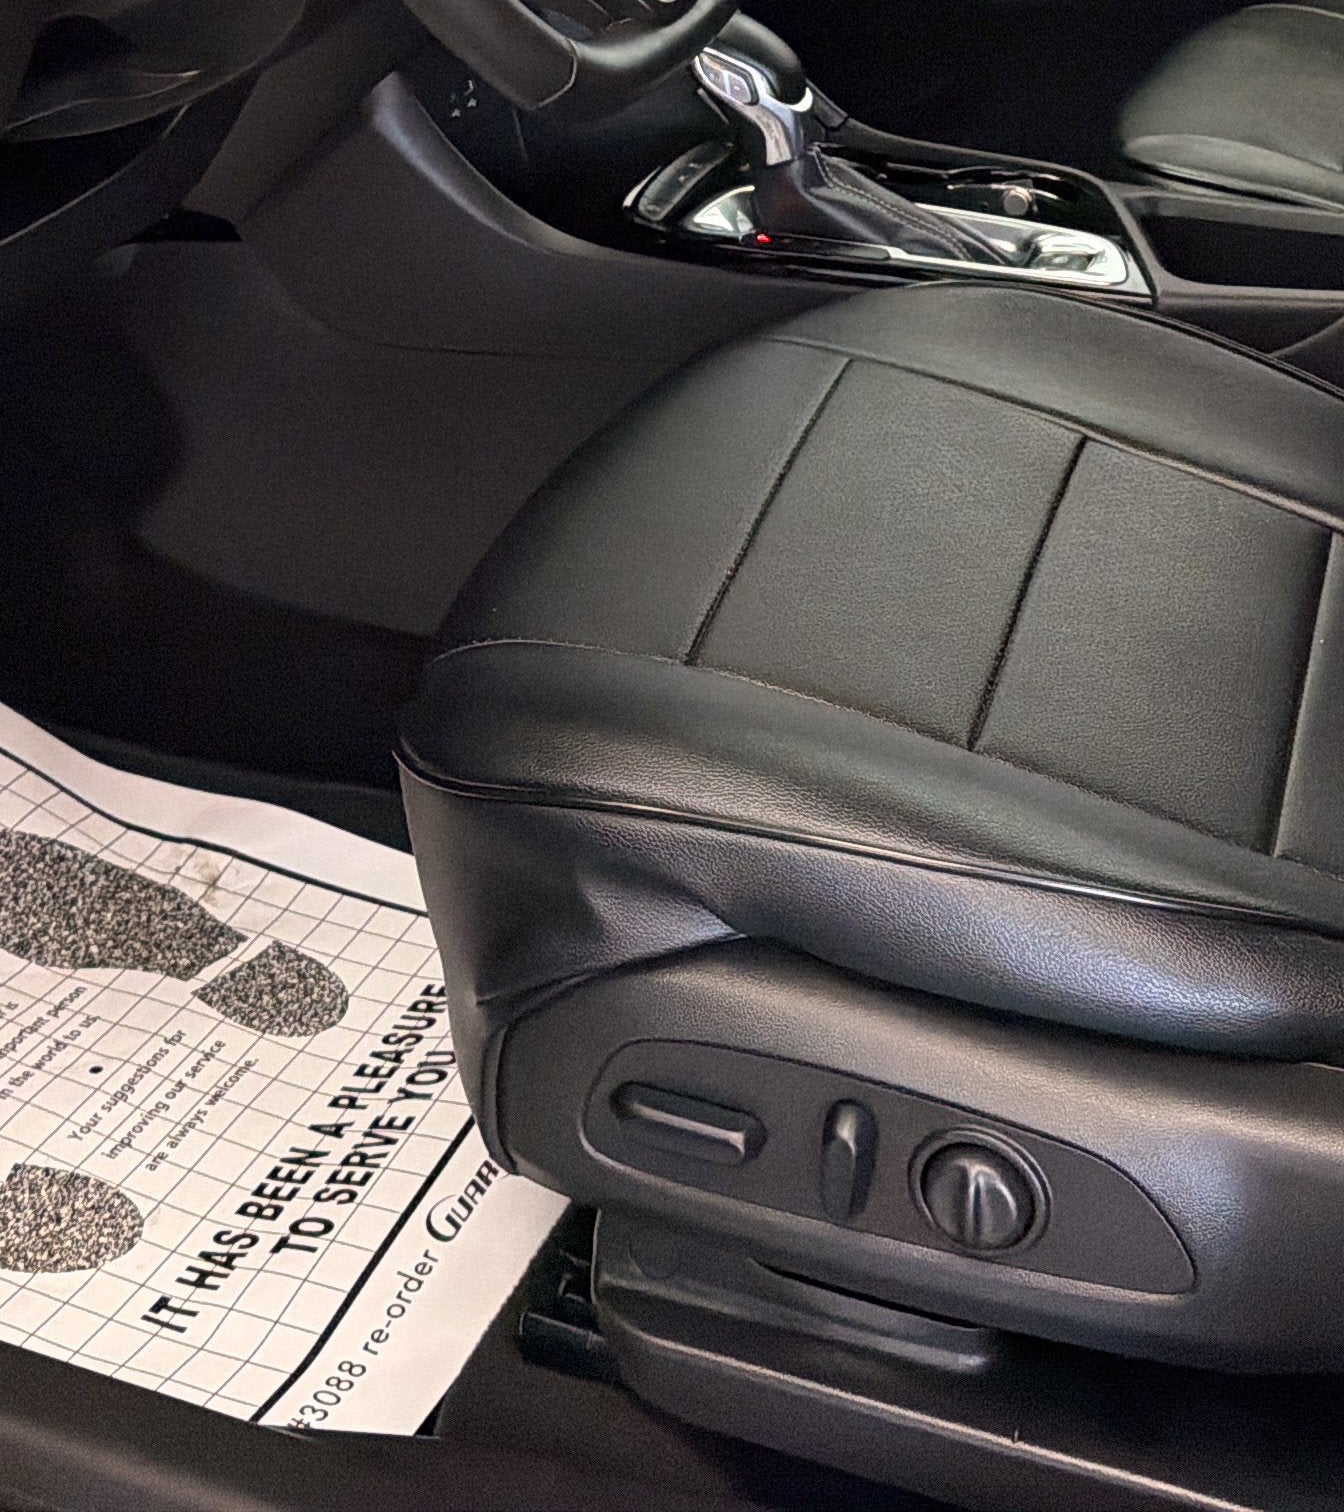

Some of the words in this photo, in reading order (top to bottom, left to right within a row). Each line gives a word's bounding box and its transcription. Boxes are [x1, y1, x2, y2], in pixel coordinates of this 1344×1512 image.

[0, 1001, 20, 1011] is
[46, 986, 88, 1019] person
[8, 1070, 36, 1088] the
[31, 1038, 69, 1071] world
[62, 1029, 82, 1042] to
[327, 983, 447, 1111] PLEASURE
[66, 1112, 104, 1142] Your
[100, 1046, 170, 1113] suggestions
[163, 1029, 188, 1047] for
[100, 1100, 171, 1160] improving
[164, 1078, 188, 1101] our
[185, 1039, 227, 1079] service
[145, 1150, 169, 1172] are
[166, 1107, 209, 1149] always
[269, 1216, 336, 1254] TO
[312, 1115, 416, 1206] SERVE
[389, 1050, 457, 1105] YOU
[307, 1119, 356, 1140] A
[234, 1146, 332, 1222] BEEN
[175, 1229, 260, 1291] HAS
[141, 1295, 200, 1334] IT
[362, 1249, 439, 1356] re-order
